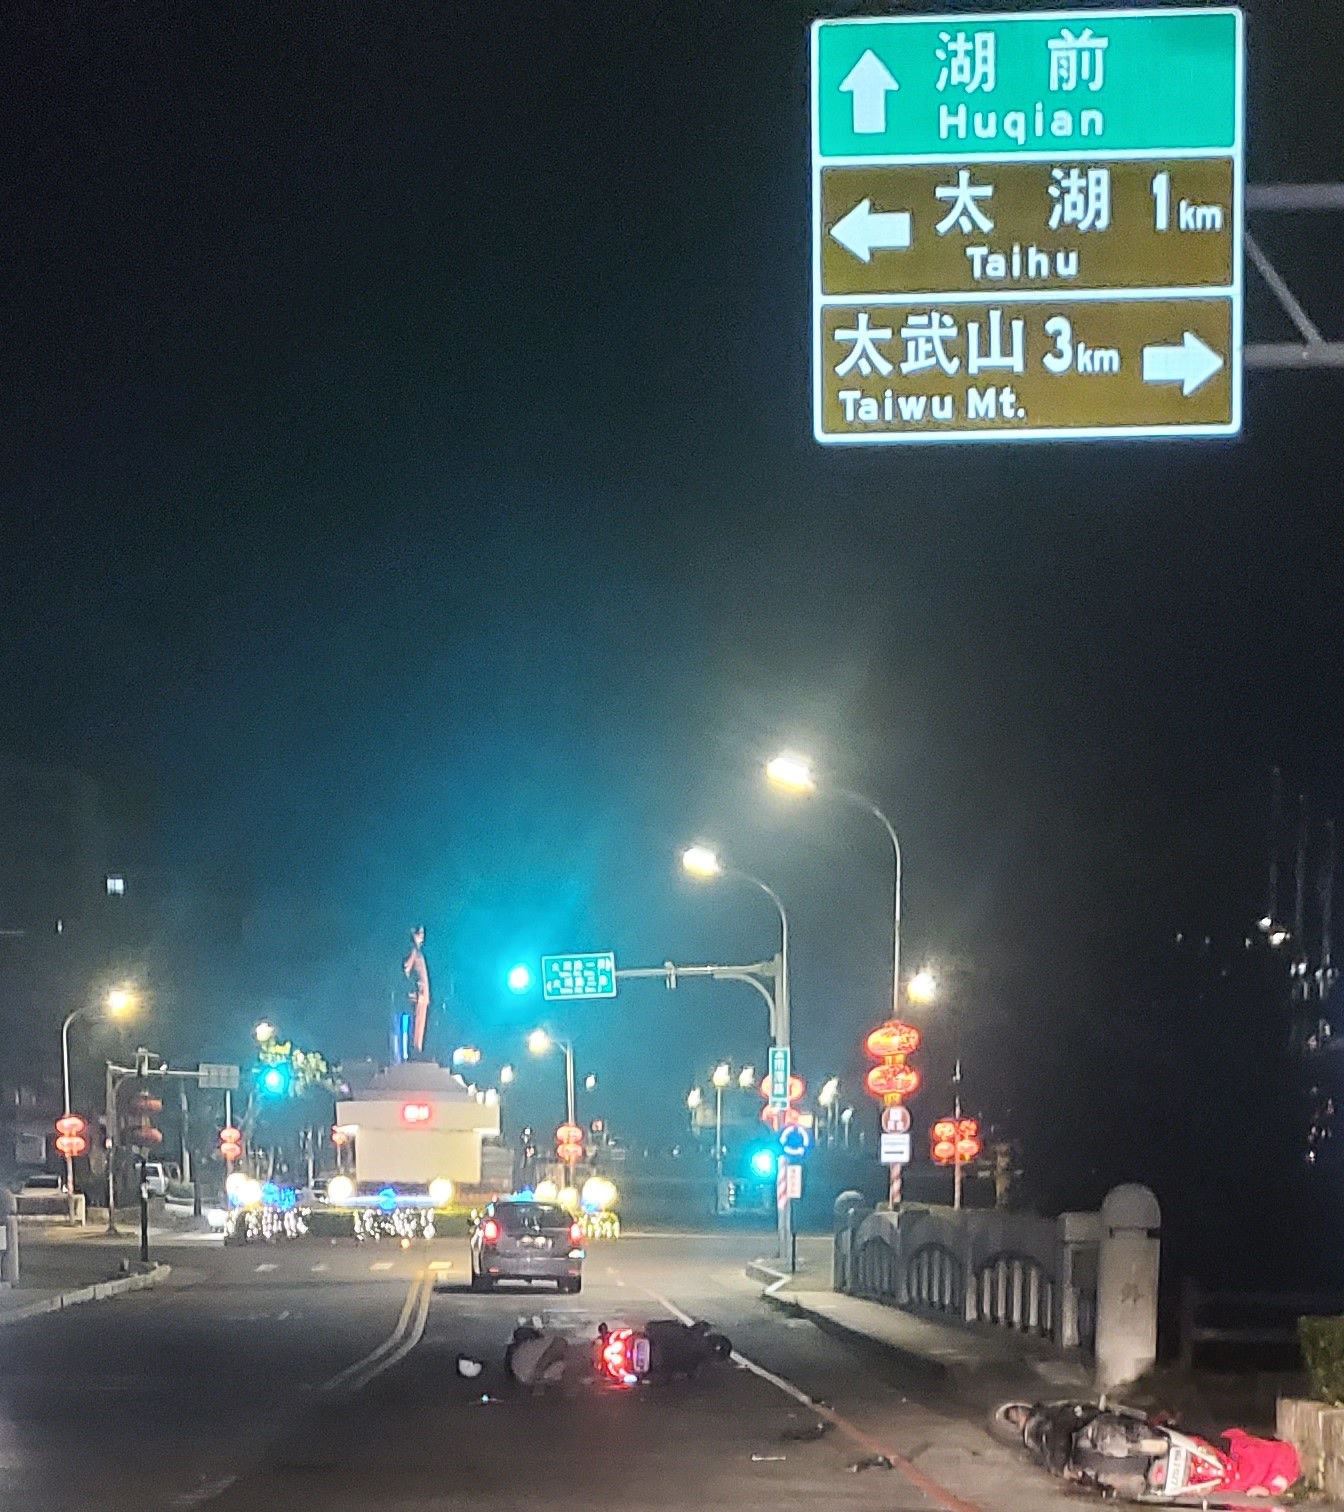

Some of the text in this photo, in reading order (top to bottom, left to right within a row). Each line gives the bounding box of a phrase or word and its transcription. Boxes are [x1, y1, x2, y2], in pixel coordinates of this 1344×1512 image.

[935, 27, 1109, 93] 湖前
[939, 101, 1104, 145] Huqian
[935, 168, 1110, 234] 太湖
[966, 243, 1078, 280] Taihu
[834, 309, 1025, 376] 太武山
[838, 385, 1026, 422] Taiwu Mt.
